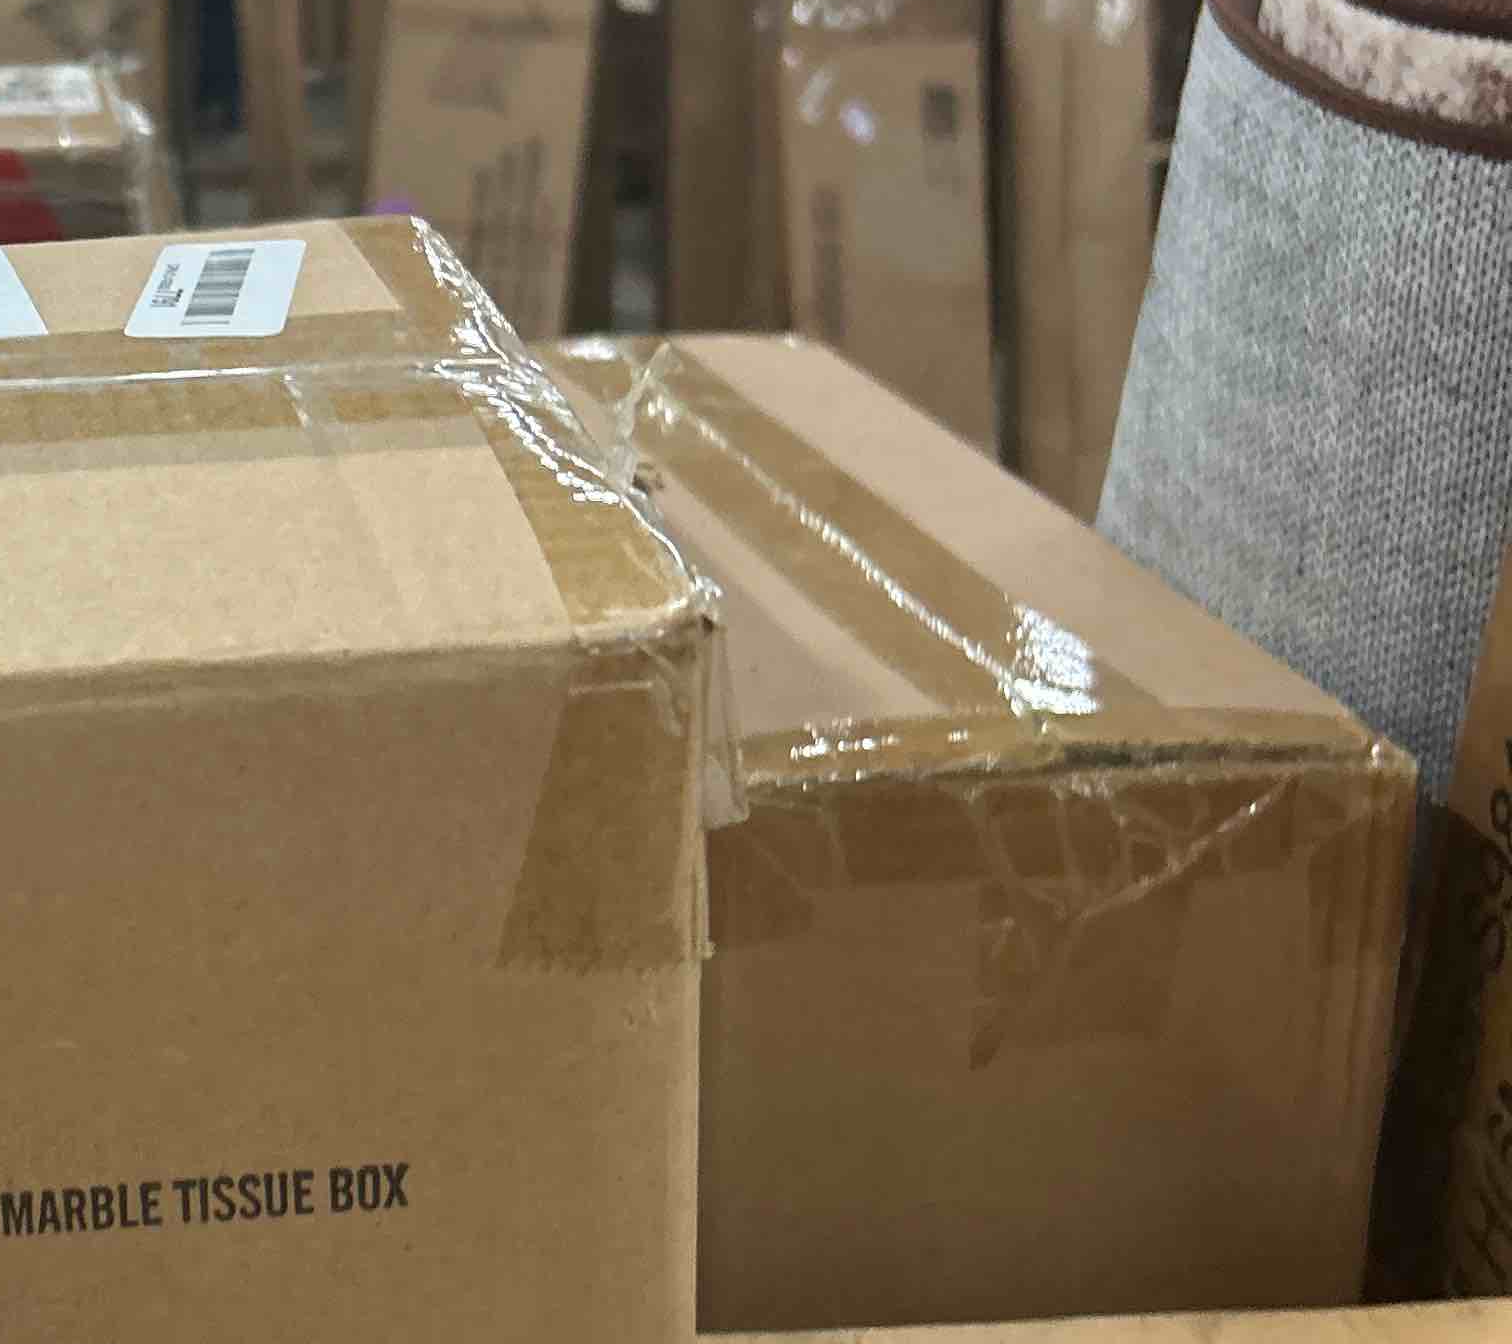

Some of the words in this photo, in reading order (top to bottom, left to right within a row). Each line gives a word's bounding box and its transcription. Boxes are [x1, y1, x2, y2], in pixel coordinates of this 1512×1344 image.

[0, 1181, 163, 1238] MARBLE
[172, 1168, 315, 1225] TISSUE
[328, 1162, 409, 1213] BOX
